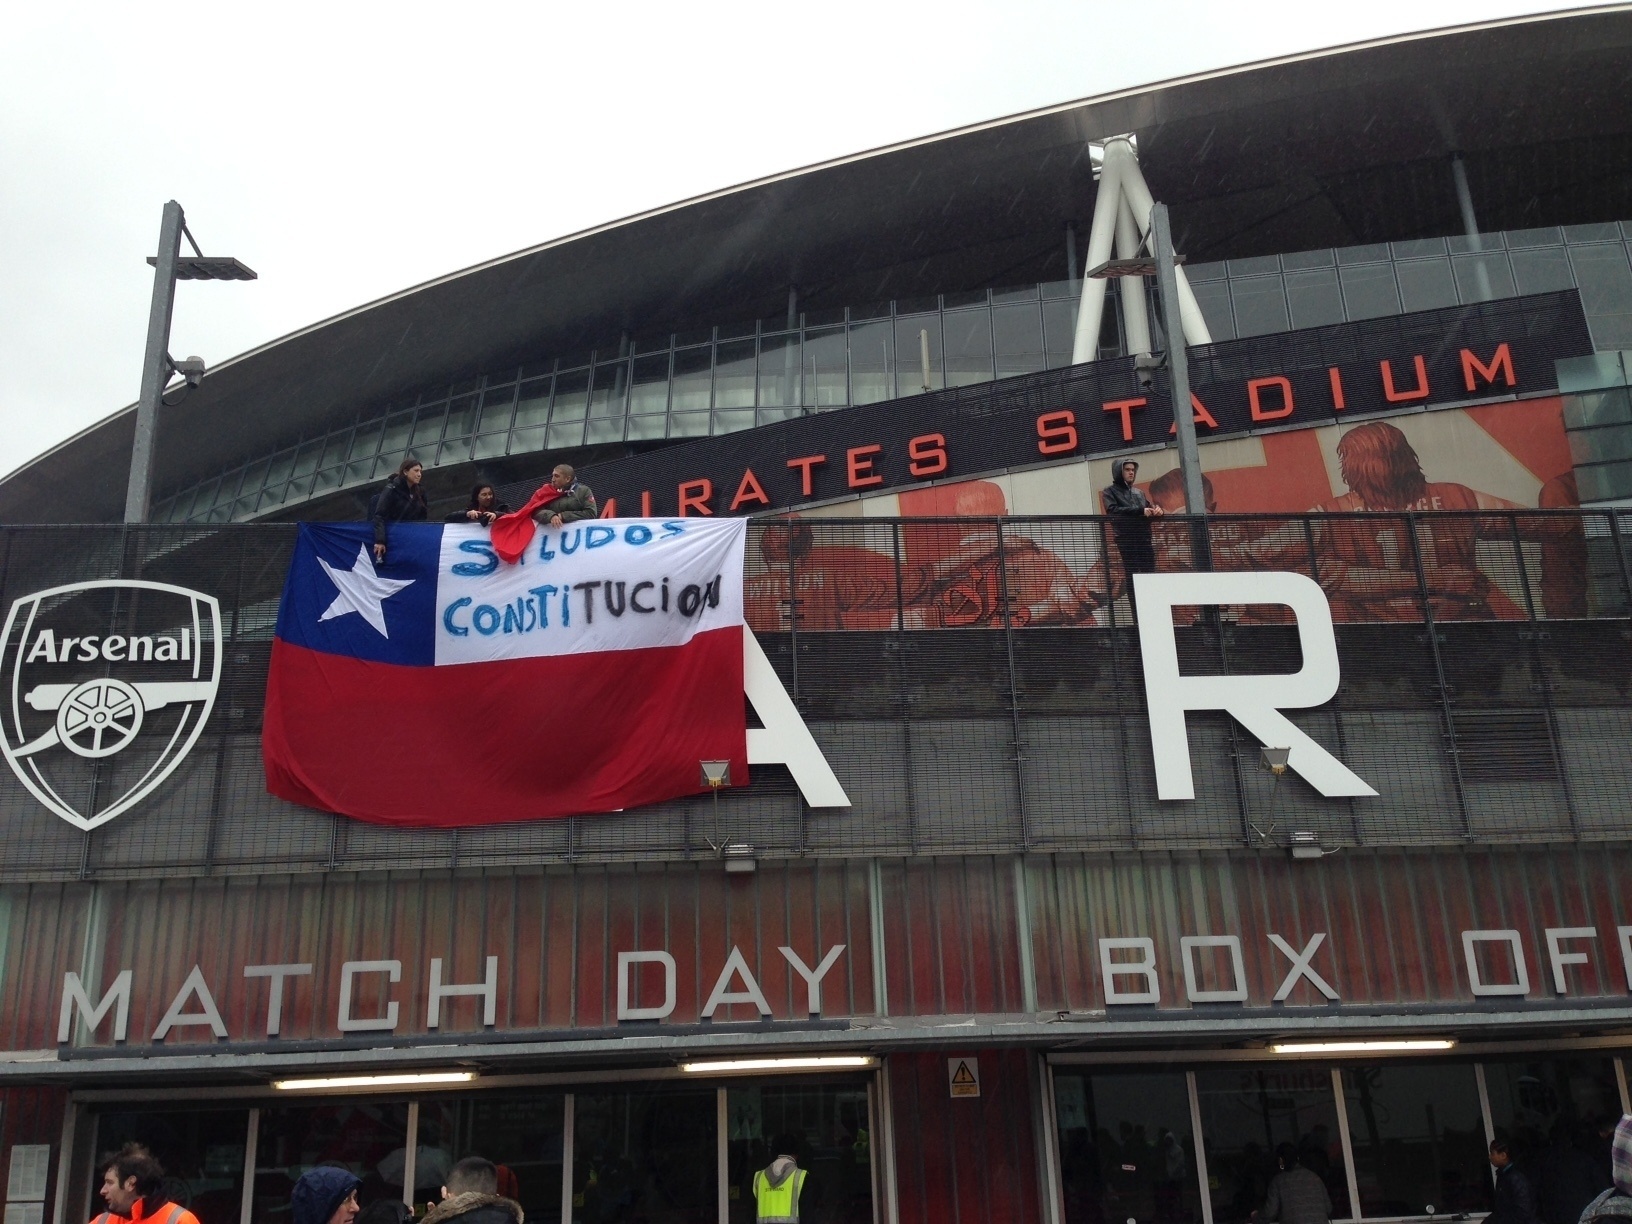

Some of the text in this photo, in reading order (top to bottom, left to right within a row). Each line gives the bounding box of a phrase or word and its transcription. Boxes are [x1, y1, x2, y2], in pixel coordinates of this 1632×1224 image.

[1037, 342, 1516, 454] STADIUM
[452, 520, 686, 576] SLUDOS
[25, 627, 191, 663] Arsenal
[57, 955, 498, 1043] MATCH
[616, 944, 846, 1021] DAY
[1098, 932, 1340, 1005] BOX
